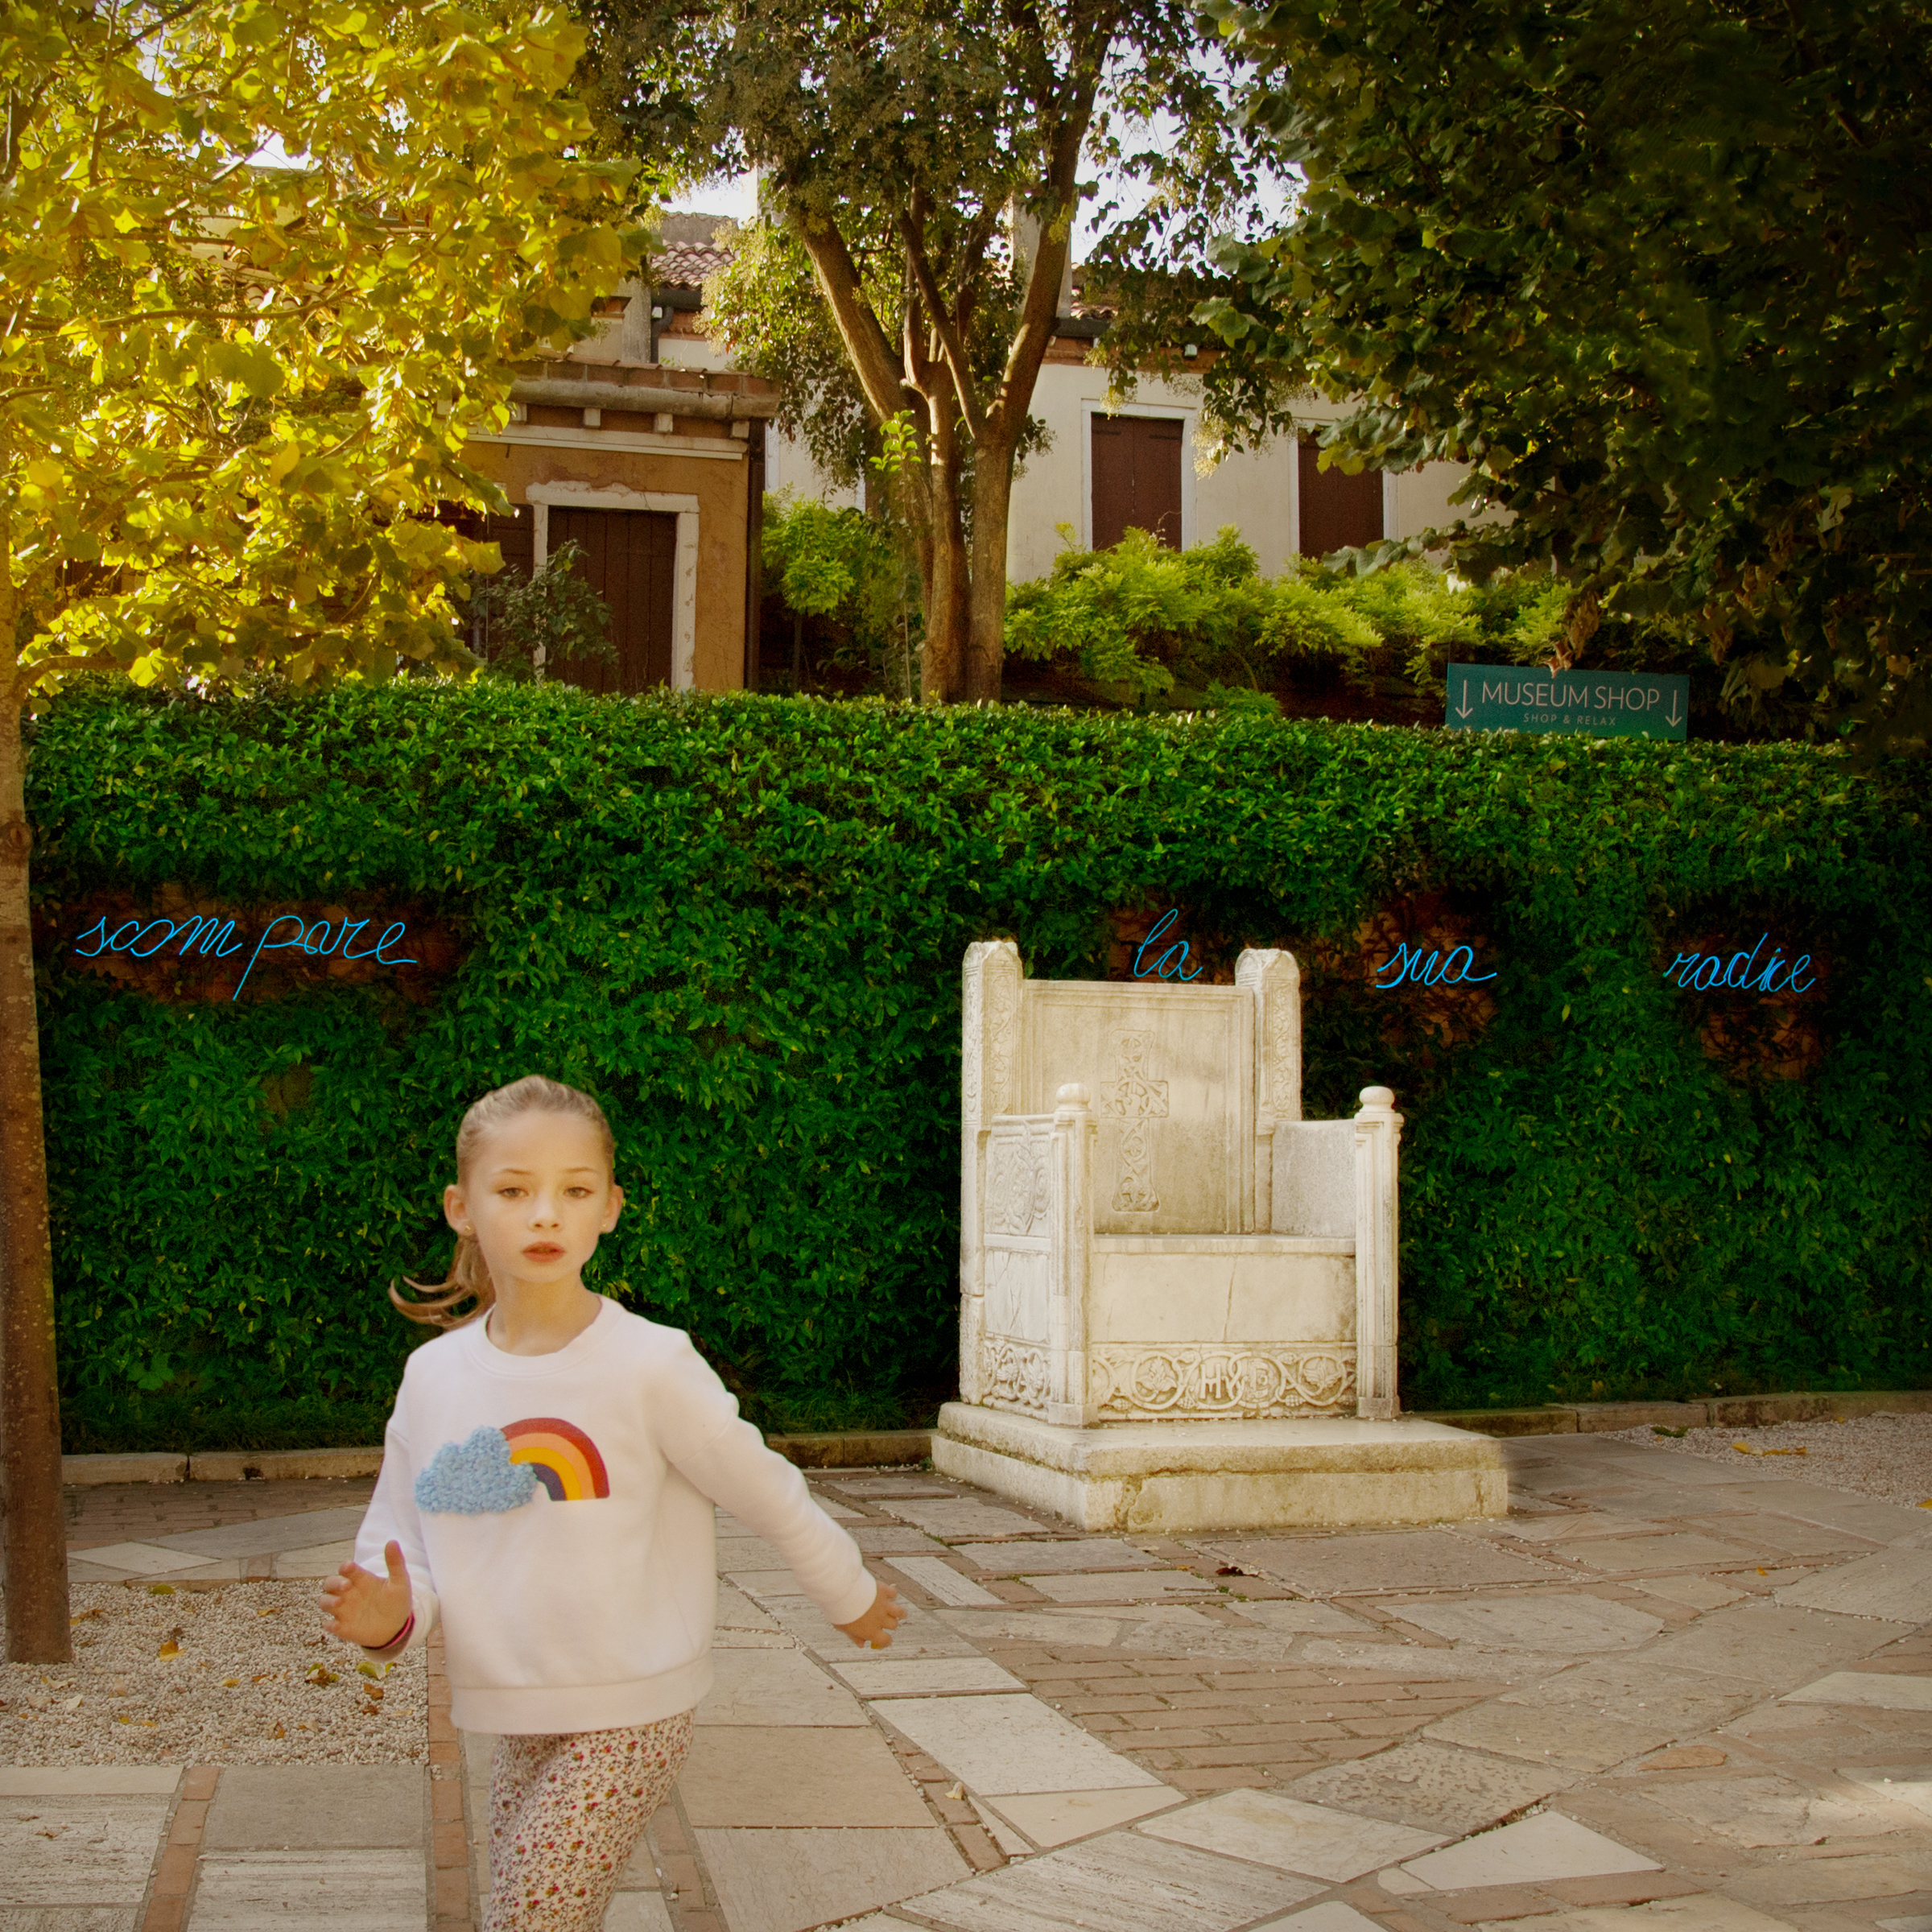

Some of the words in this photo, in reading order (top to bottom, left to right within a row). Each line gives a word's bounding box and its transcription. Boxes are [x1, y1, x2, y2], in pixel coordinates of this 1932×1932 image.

[1482, 681, 1587, 708] MUSEUM
[1594, 686, 1660, 711] SHOP
[1523, 712, 1557, 723] SHOP
[1563, 714, 1571, 724] &
[1576, 715, 1616, 726] RELAX
[1133, 908, 1203, 980] la
[1375, 942, 1498, 989] sua
[1662, 932, 1816, 993] radice
